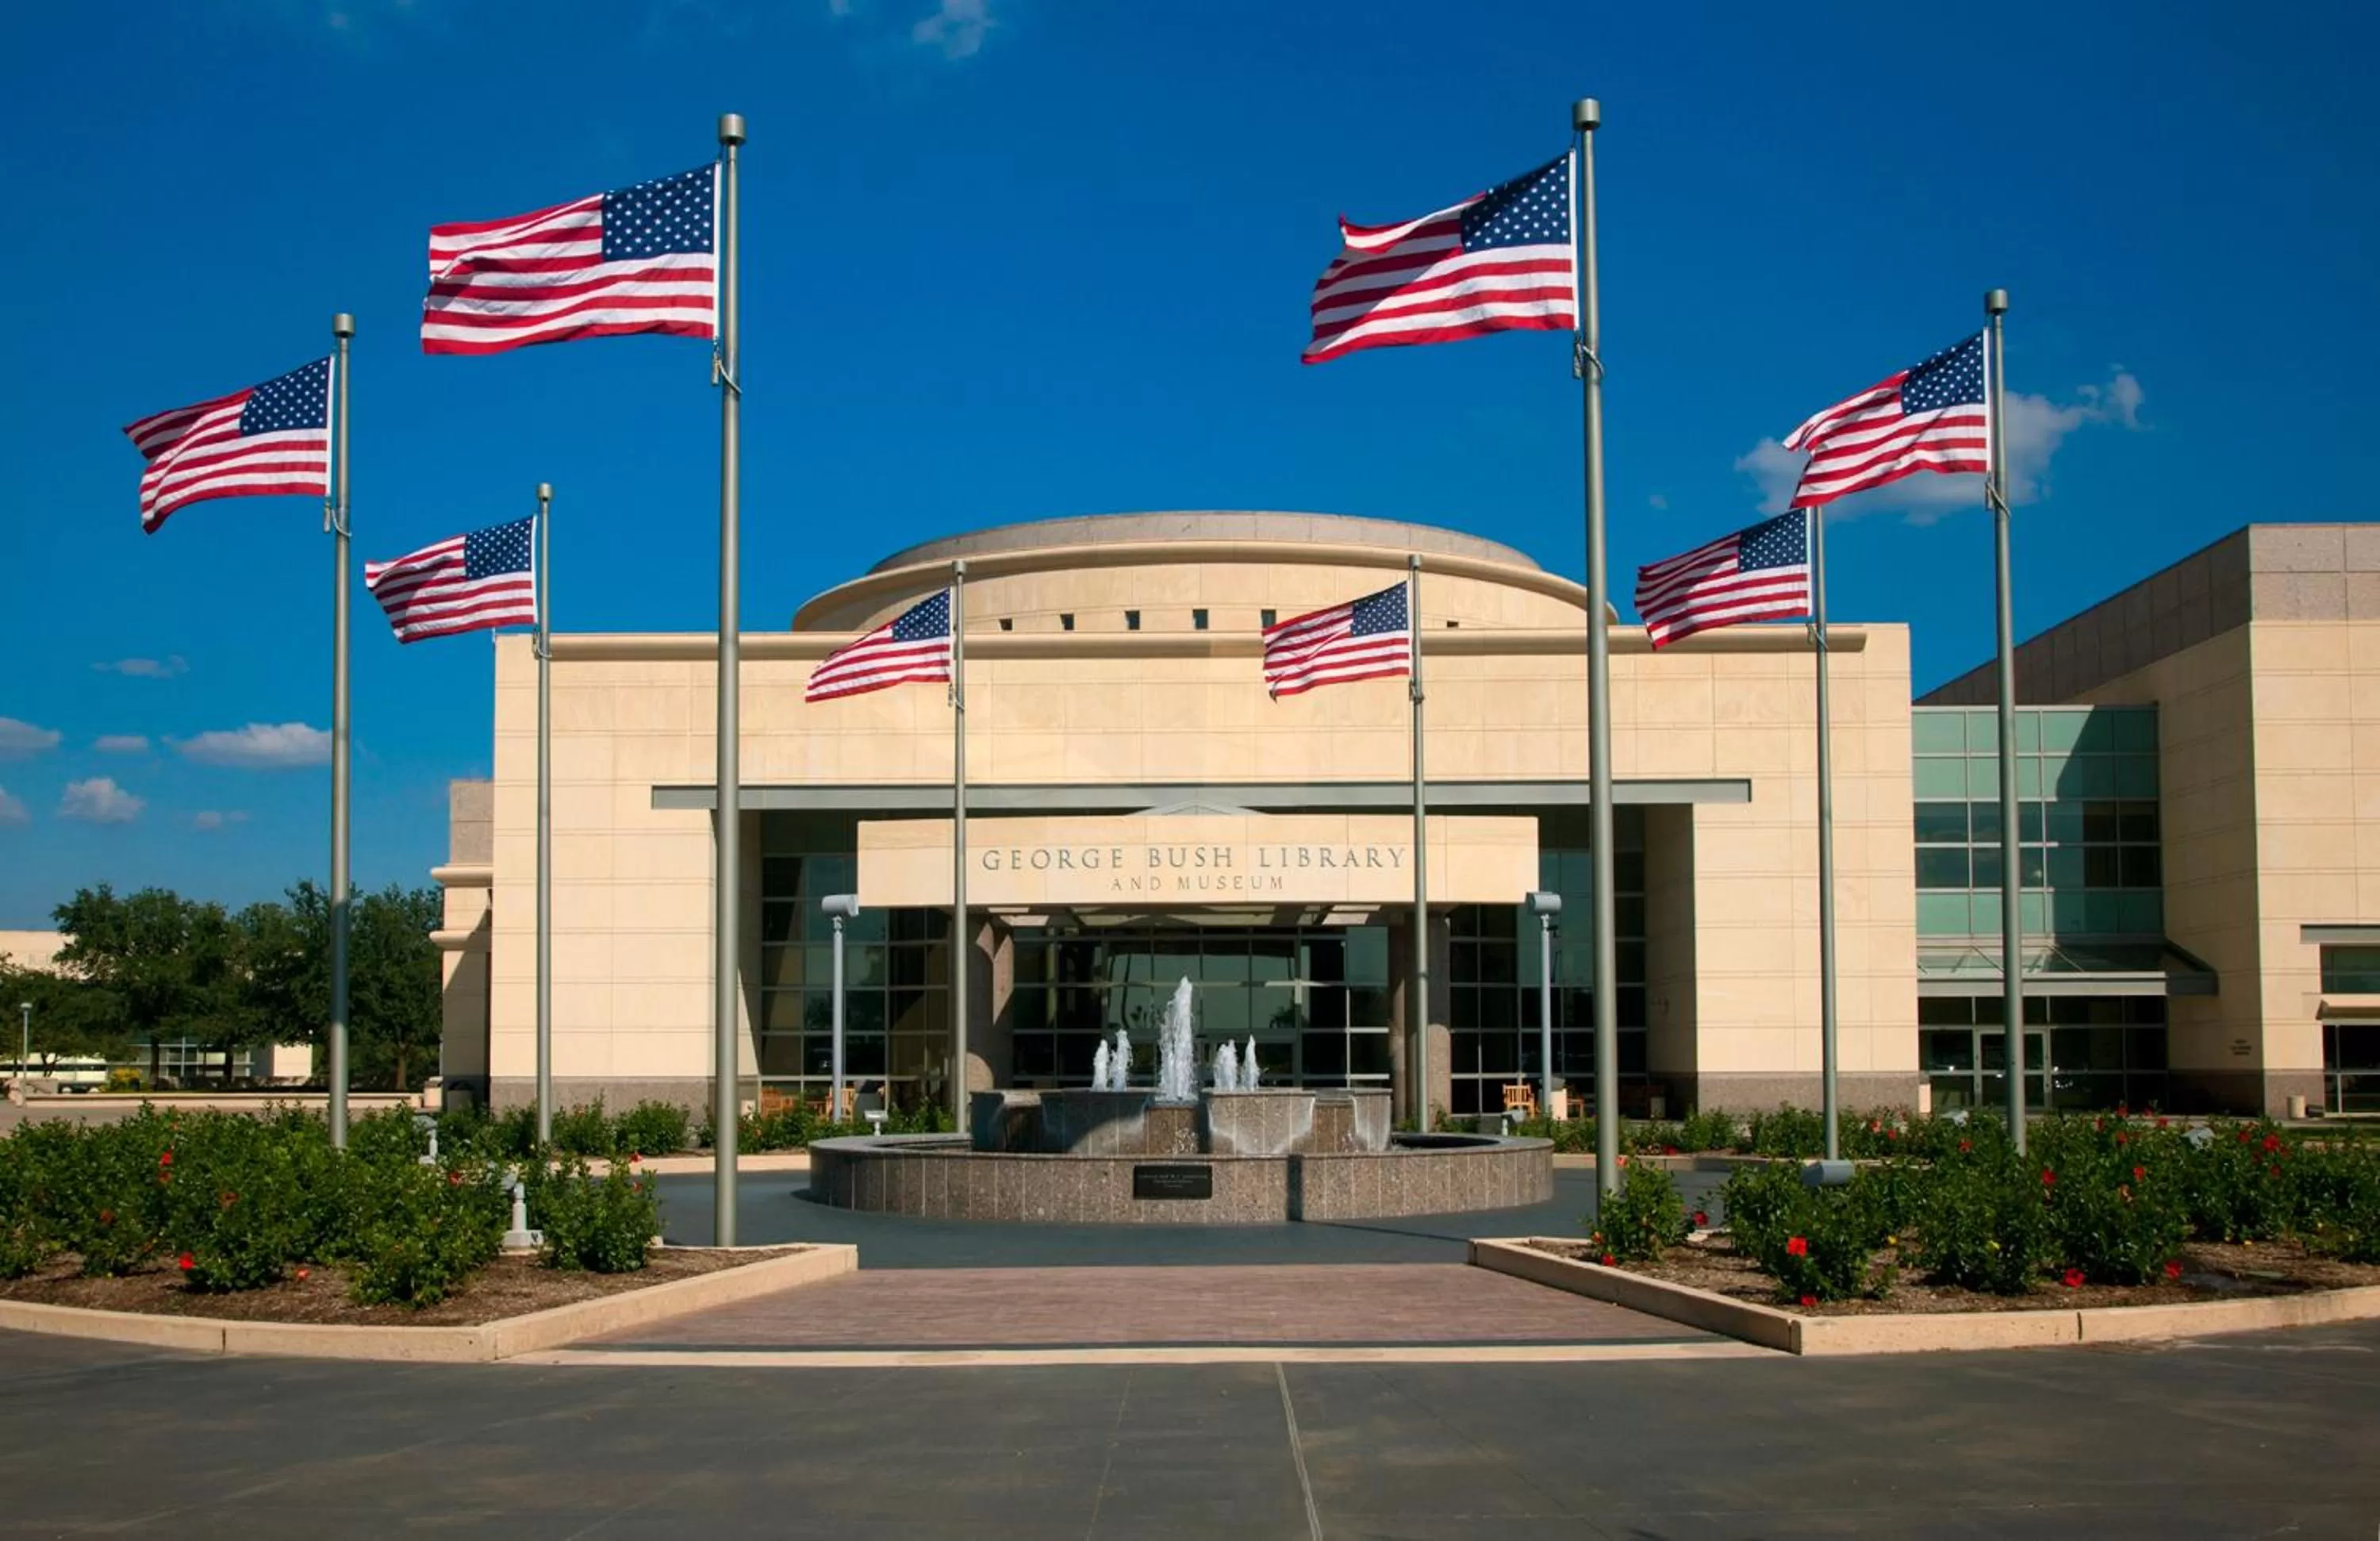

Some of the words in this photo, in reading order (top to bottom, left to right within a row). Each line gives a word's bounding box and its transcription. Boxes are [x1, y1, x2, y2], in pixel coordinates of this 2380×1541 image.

[982, 849, 1123, 870] GEORGE
[1149, 847, 1232, 868] BUSH
[1259, 847, 1406, 868] LIBRARY
[1111, 876, 1161, 890] AND
[1177, 875, 1284, 890] MUSEUM
